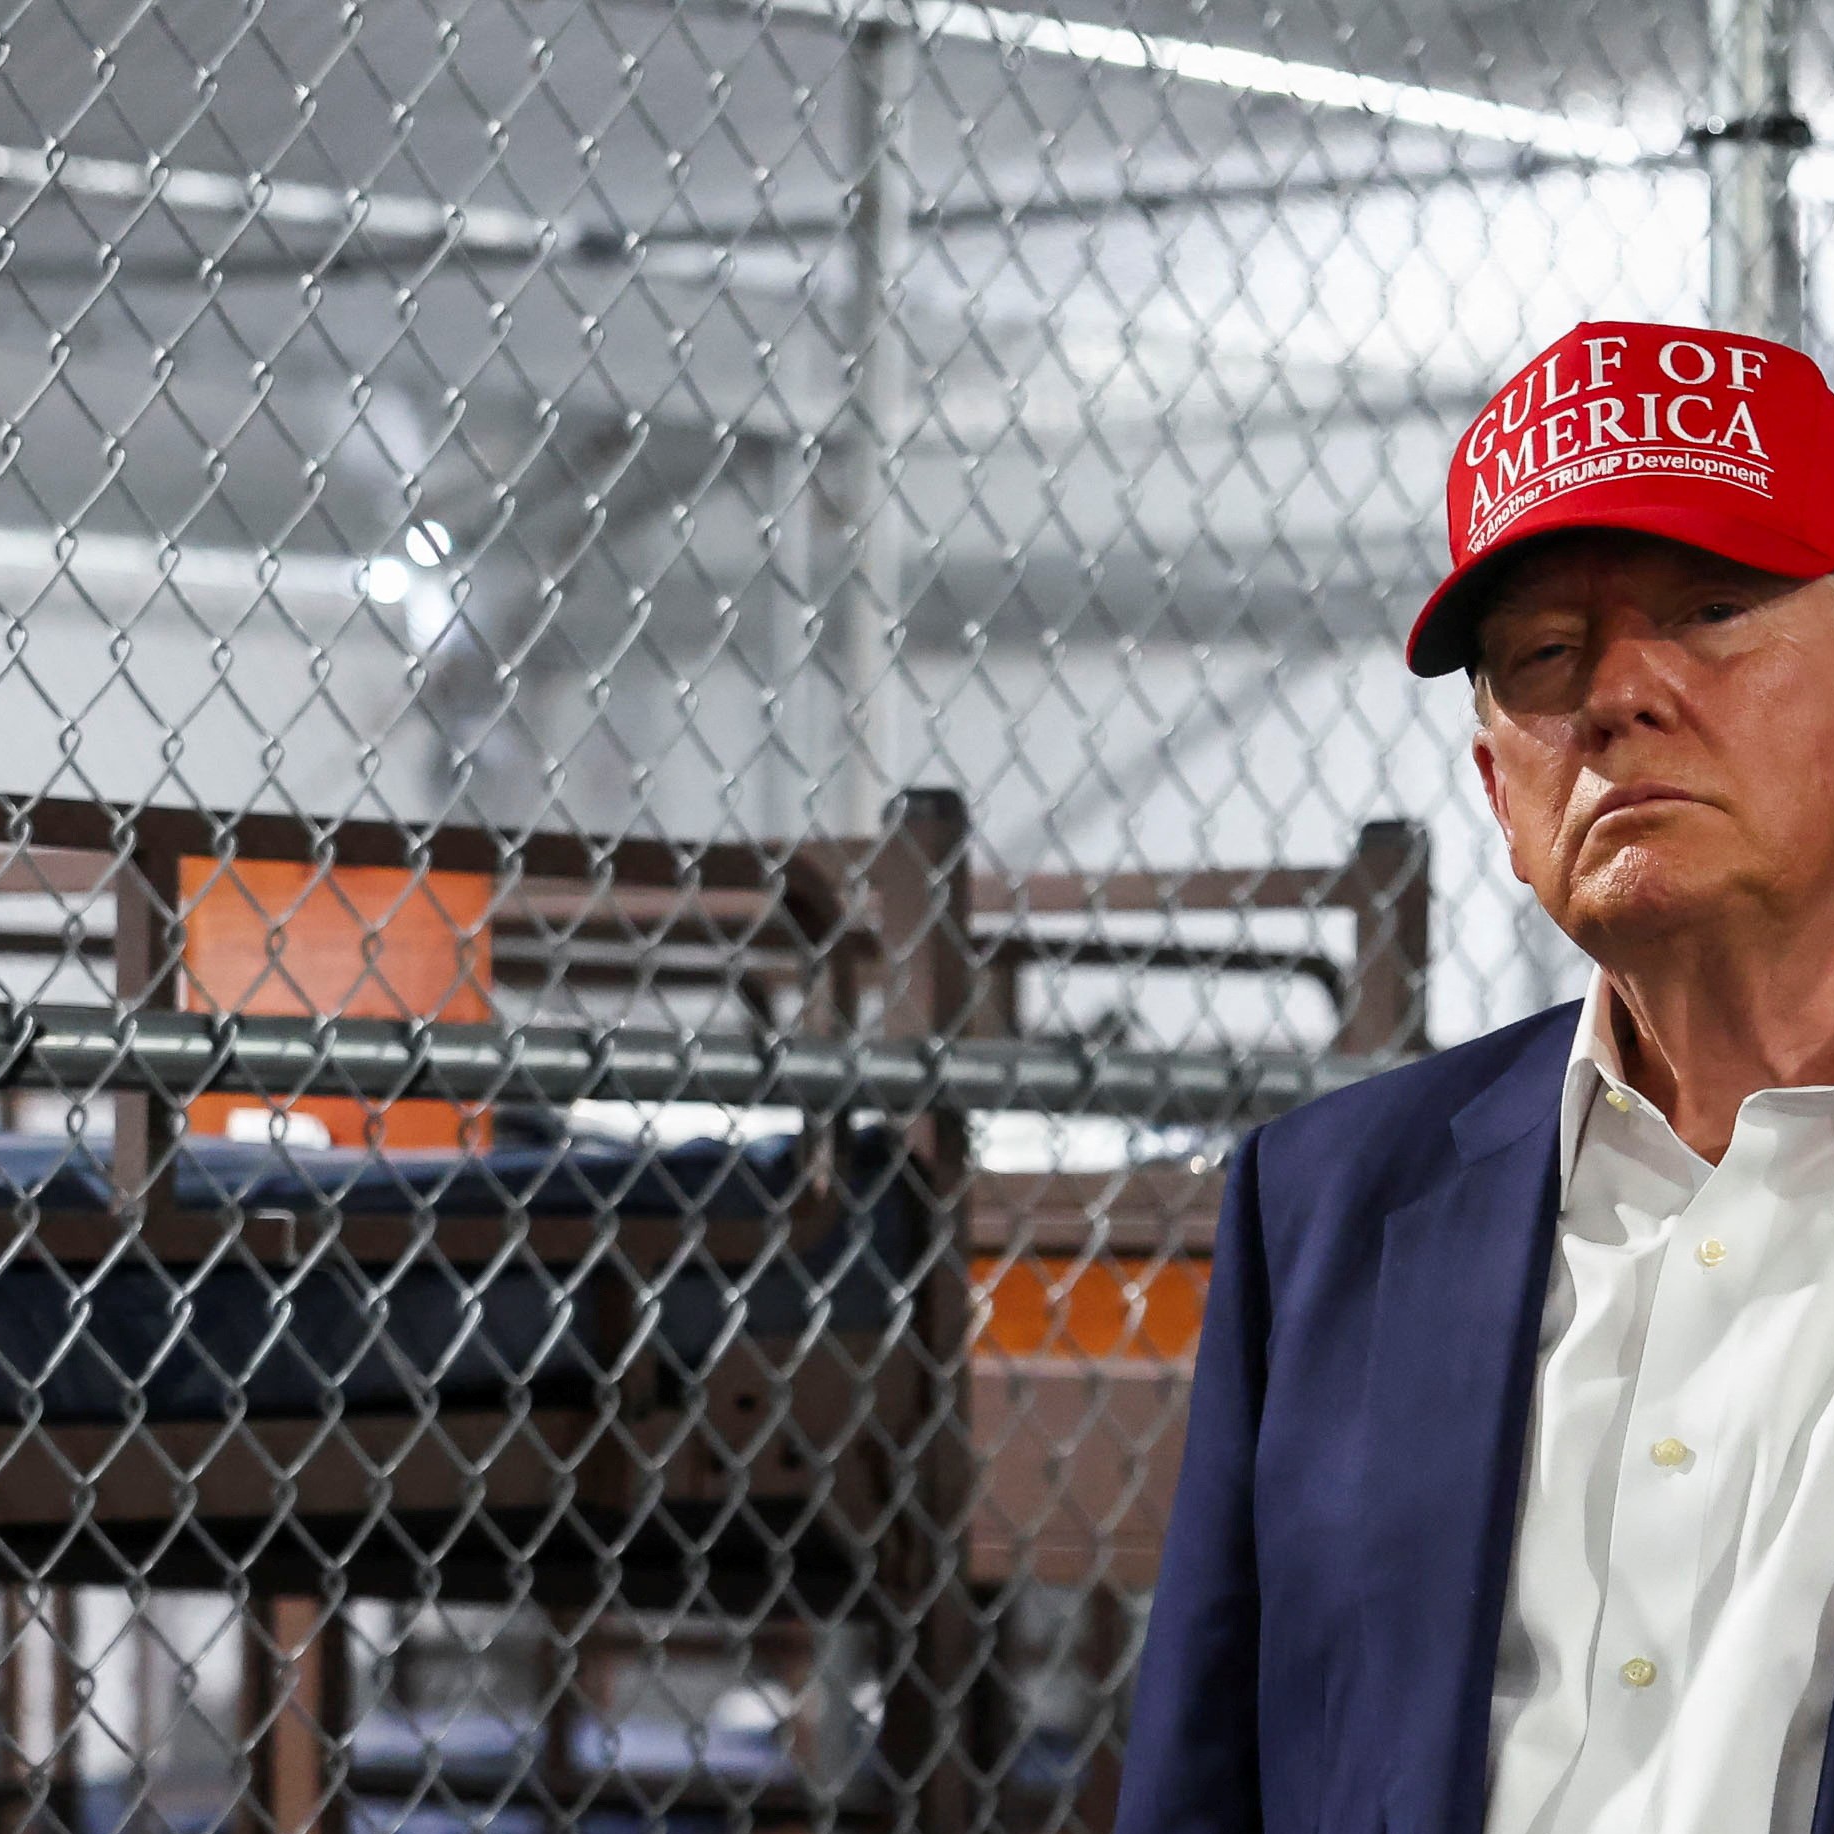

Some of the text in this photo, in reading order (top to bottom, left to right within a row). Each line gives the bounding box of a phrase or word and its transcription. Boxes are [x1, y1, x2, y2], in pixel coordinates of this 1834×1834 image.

[1465, 336, 1767, 467] GULF OF
[1467, 393, 1769, 536] AMERICA
[1486, 484, 1544, 540] Another
[1545, 455, 1623, 492] TRUMP
[1627, 452, 1769, 490] Development
